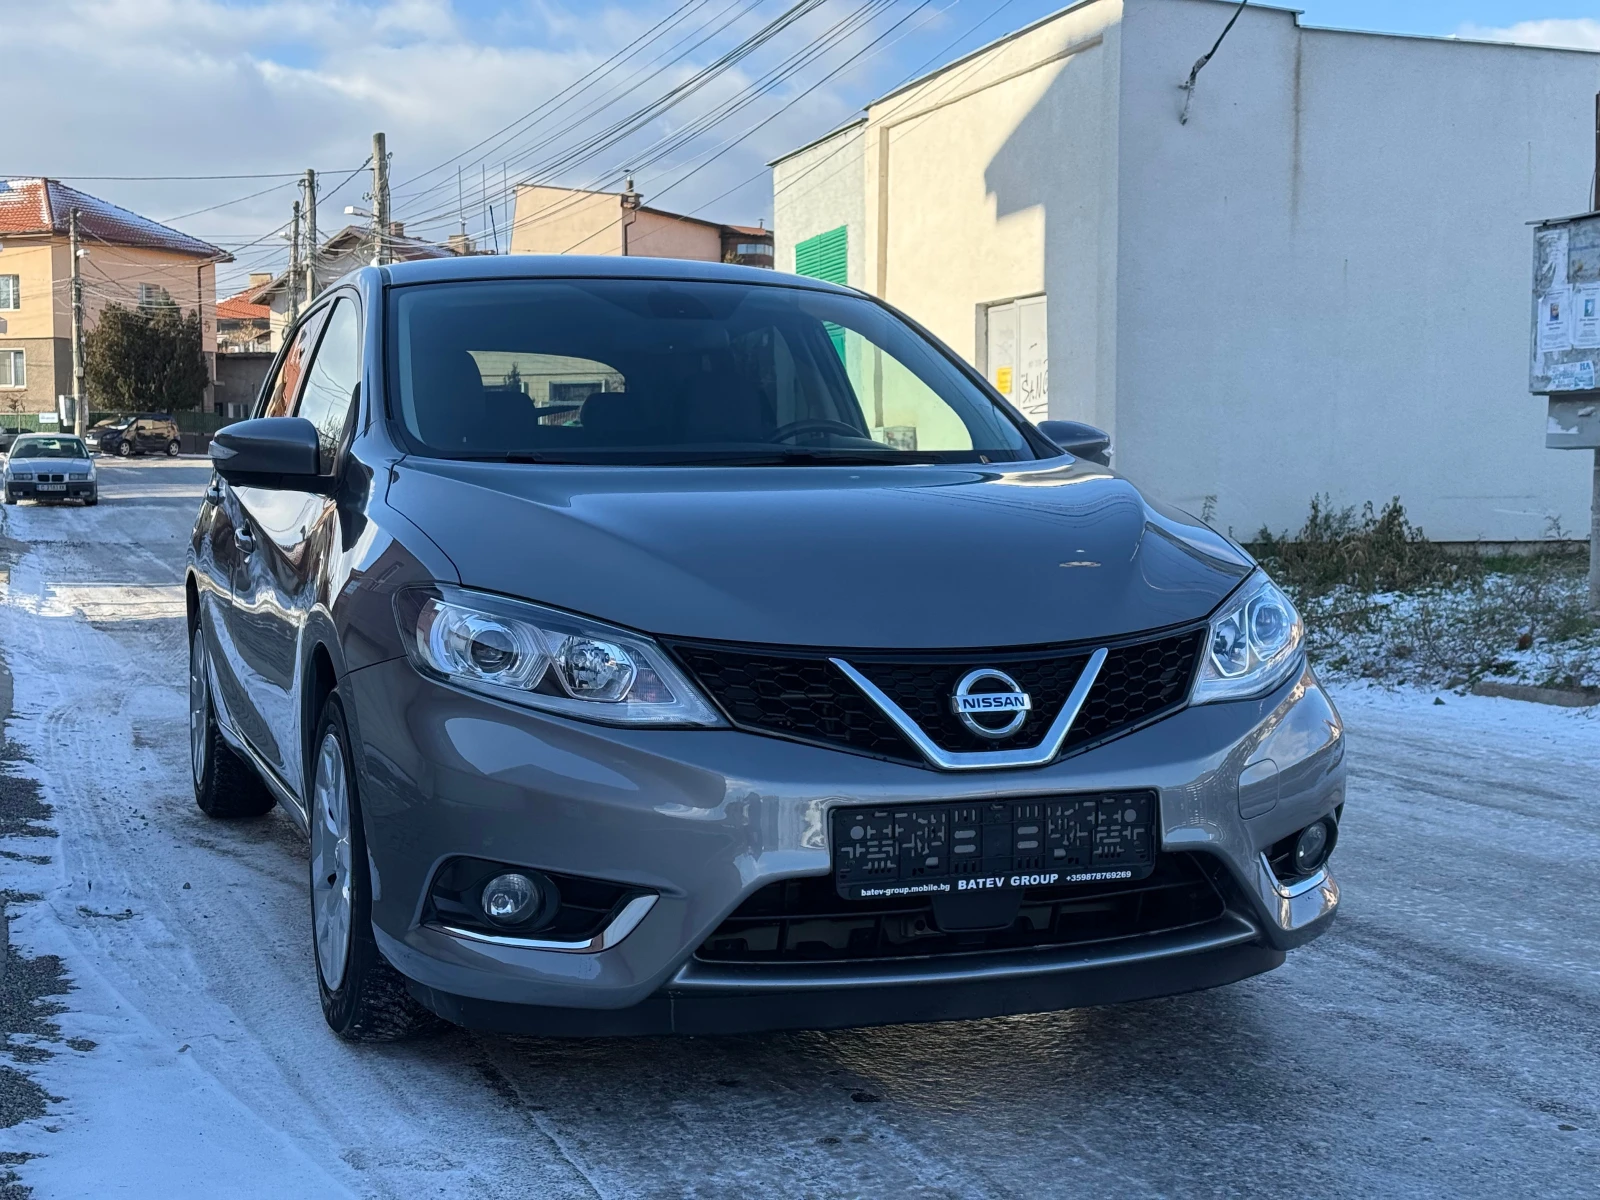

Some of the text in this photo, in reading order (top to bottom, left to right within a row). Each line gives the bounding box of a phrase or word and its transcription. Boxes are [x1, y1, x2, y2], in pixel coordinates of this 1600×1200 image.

[962, 696, 1025, 709] NISSAN
[861, 870, 1132, 896] batev-group.mobile.bg BATEV GROUP +359878769269
